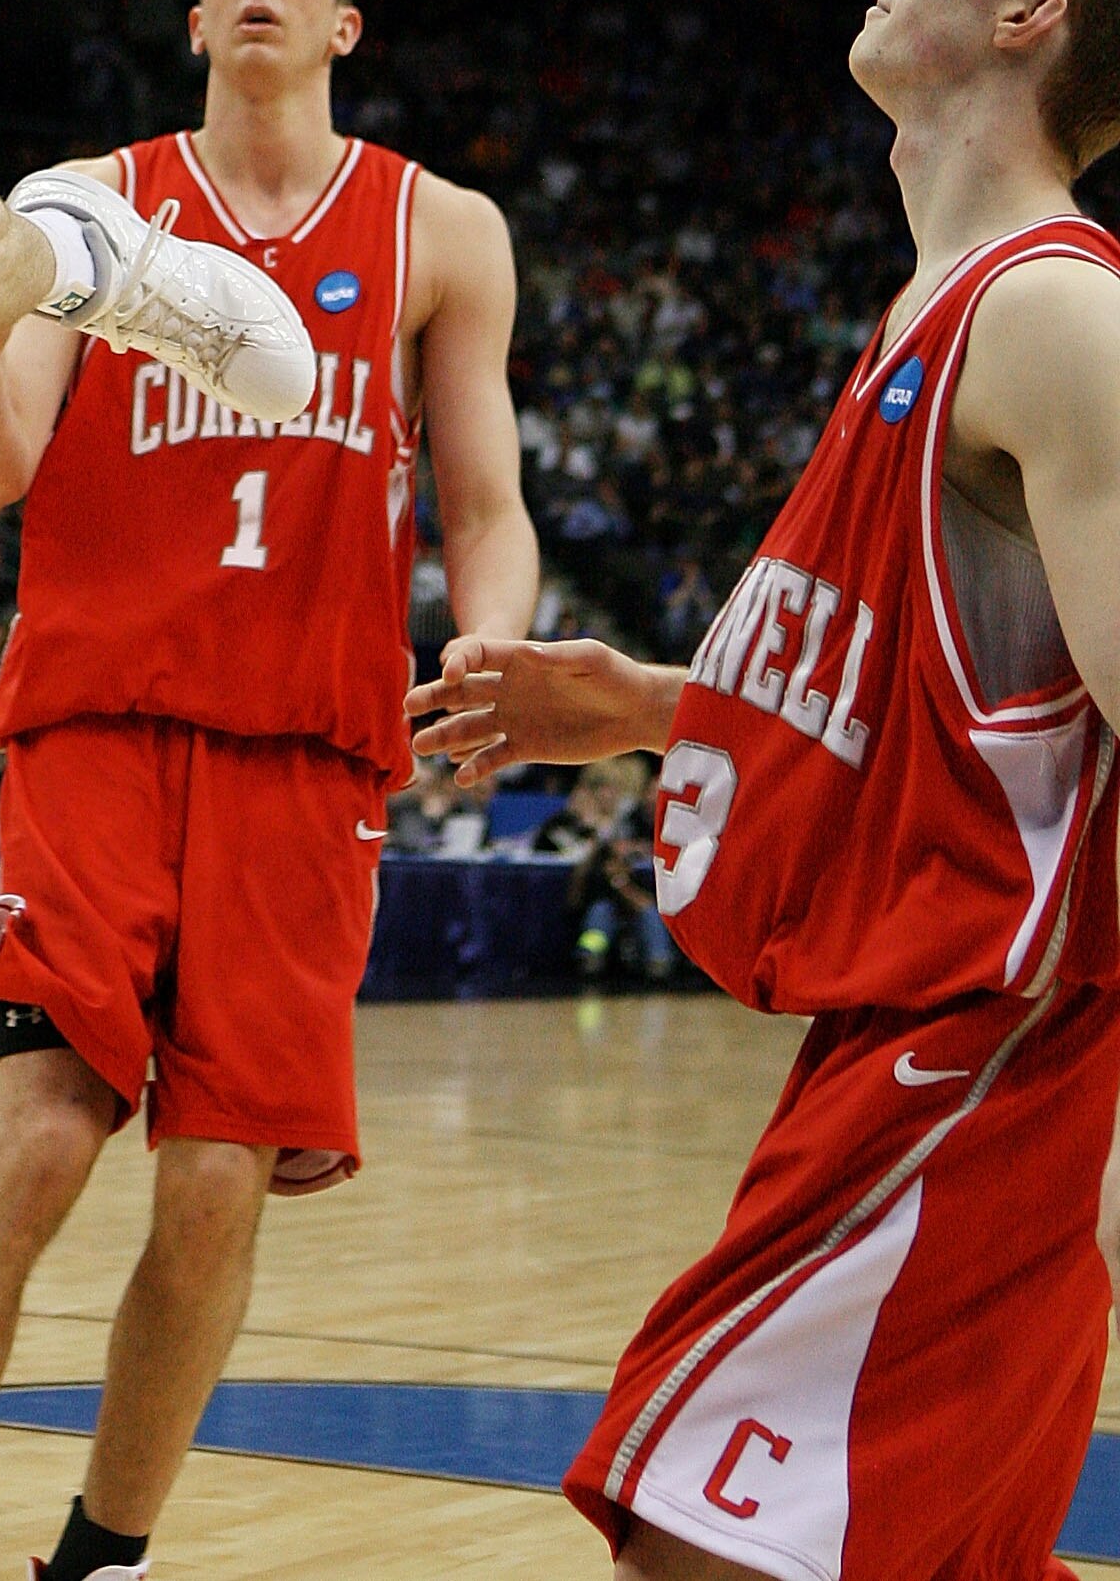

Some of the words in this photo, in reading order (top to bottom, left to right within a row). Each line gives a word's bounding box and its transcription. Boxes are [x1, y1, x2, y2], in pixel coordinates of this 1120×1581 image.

[263, 247, 278, 269] C
[220, 470, 269, 570] 1
[652, 738, 740, 917] 3
[702, 1418, 793, 1520] C
